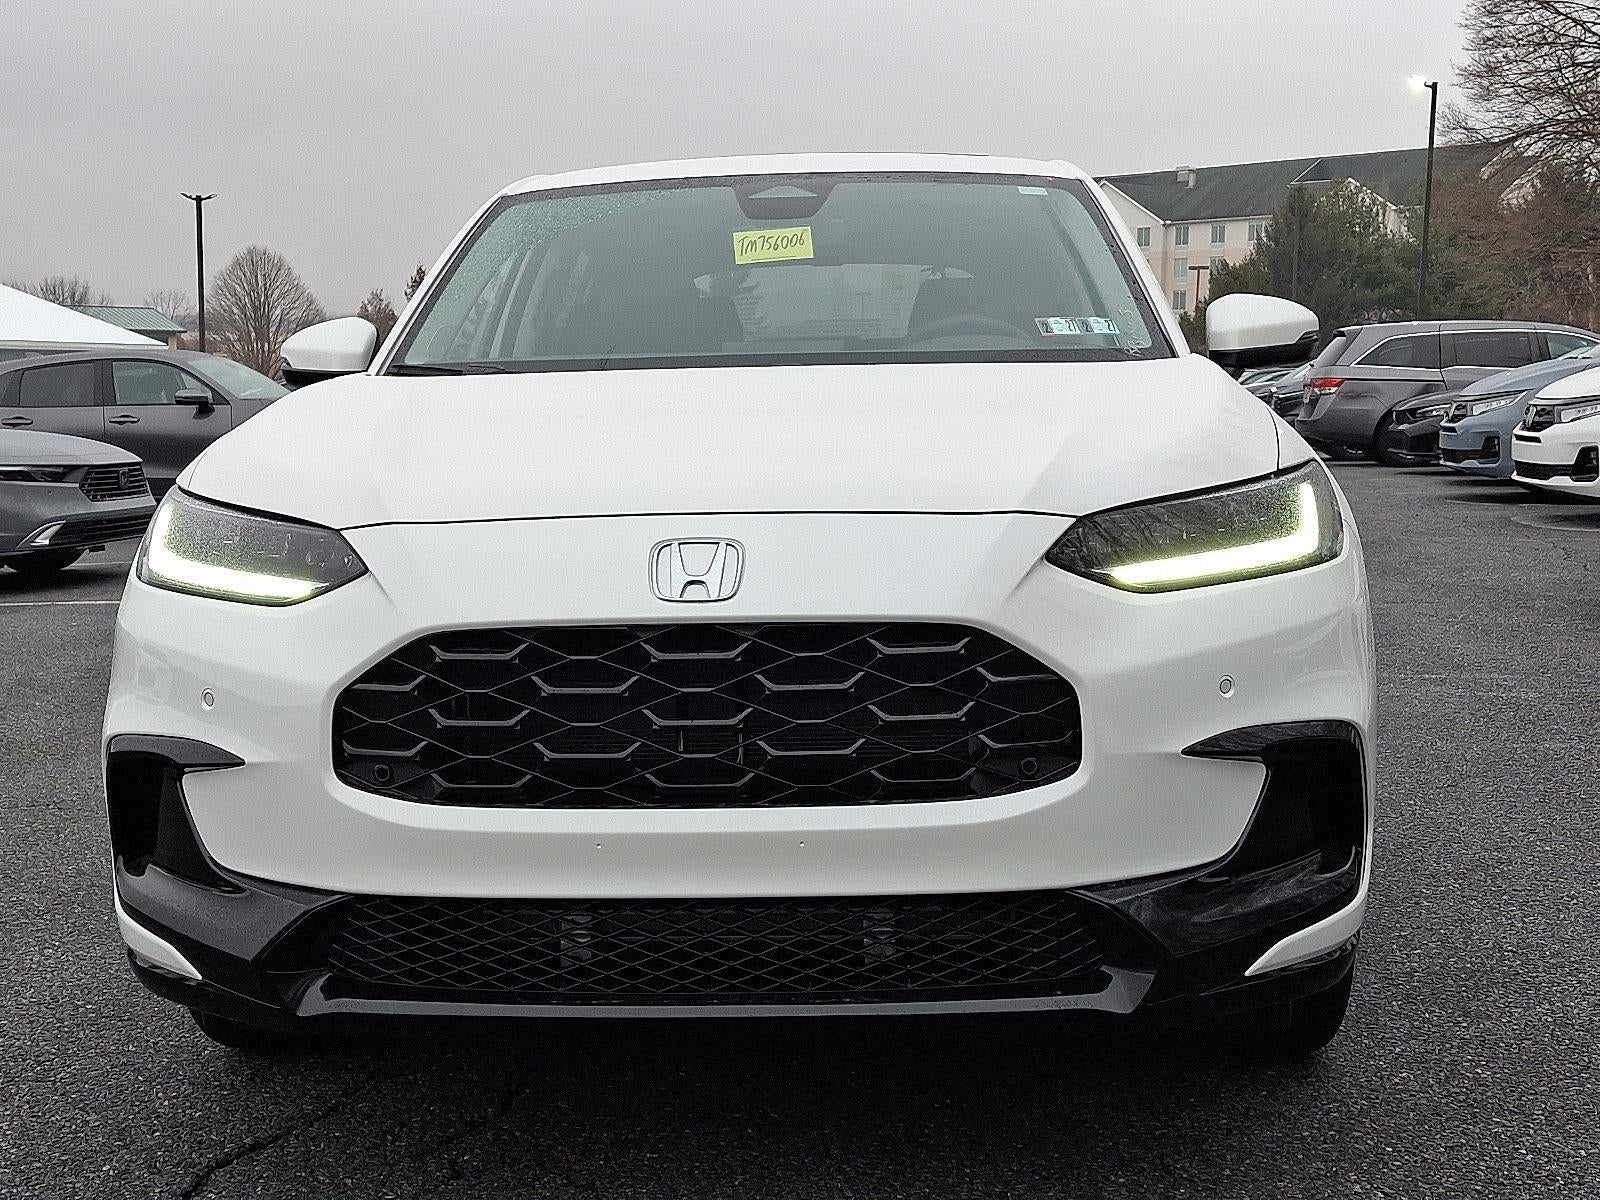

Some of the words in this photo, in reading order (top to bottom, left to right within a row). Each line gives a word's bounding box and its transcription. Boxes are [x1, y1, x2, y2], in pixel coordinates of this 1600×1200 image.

[737, 231, 805, 256] TM756006
[1064, 319, 1077, 333] 27
[1103, 319, 1117, 333] 27
